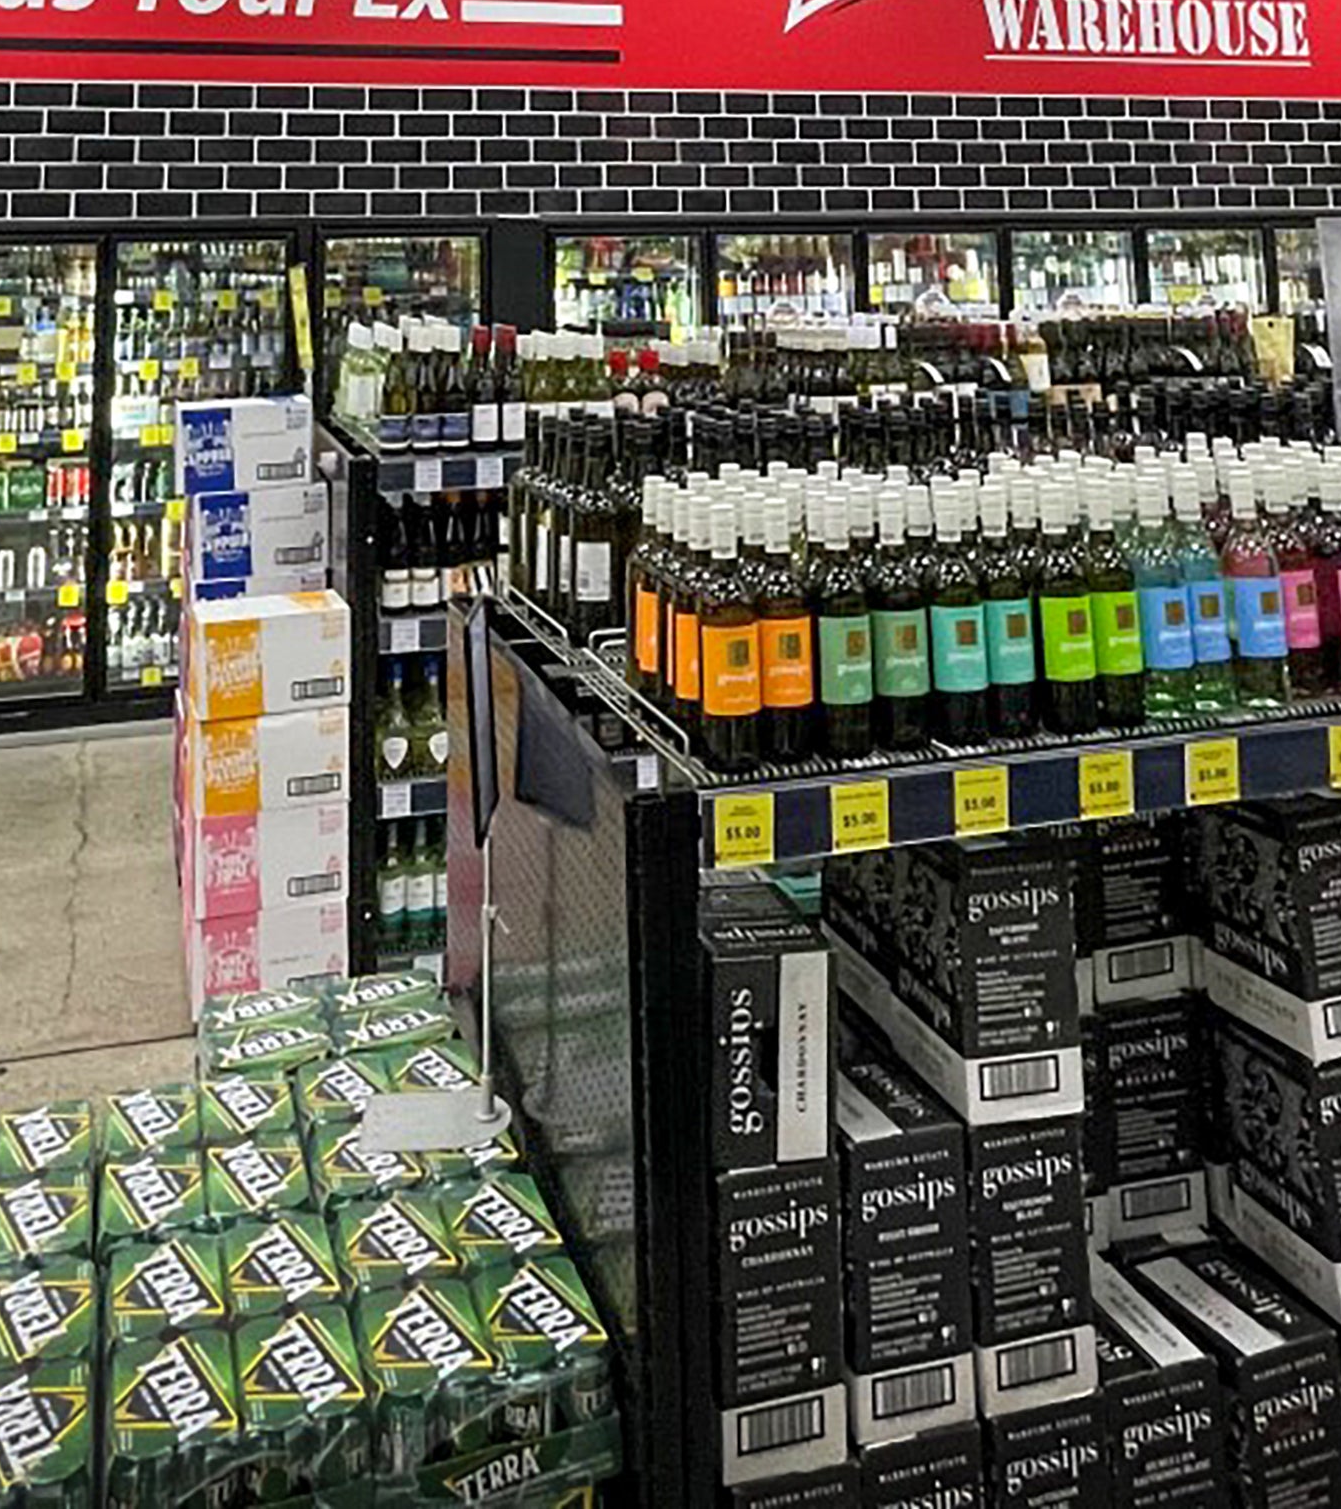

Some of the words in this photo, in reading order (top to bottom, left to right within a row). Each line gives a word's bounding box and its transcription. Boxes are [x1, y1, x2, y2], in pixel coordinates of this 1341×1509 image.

[725, 825, 761, 841] $5.00
[968, 879, 1061, 923] gossips
[212, 991, 318, 1030] TERRA
[334, 975, 432, 1012] TERRA
[219, 1026, 329, 1069] TERRA
[346, 1008, 450, 1047] TERRA
[795, 1001, 809, 1115] CHARDONNAY
[1107, 1028, 1190, 1070] gossips
[720, 987, 764, 1135] gossips
[14, 1107, 70, 1172] TERRA
[117, 1157, 185, 1230] TERRA
[221, 1142, 289, 1210] TERRA
[860, 1172, 957, 1223] gossips
[981, 1148, 1073, 1200] gossips
[4, 1179, 67, 1260] TERRA
[362, 1203, 441, 1275] TERRA
[464, 1182, 549, 1253] TERRA
[729, 1199, 830, 1253] gossips
[134, 1245, 209, 1326] TERRA
[249, 1225, 326, 1302] TERRA
[0, 1271, 68, 1359] TERRA
[385, 1291, 476, 1380] TERRA
[499, 1272, 588, 1352] TERRA
[139, 1345, 223, 1442] TERRA
[261, 1321, 348, 1413] TERRA
[1122, 1403, 1213, 1459] gossips
[1252, 1376, 1336, 1433] gossips
[456, 1446, 540, 1498] TERRA
[1005, 1438, 1100, 1495] gossips
